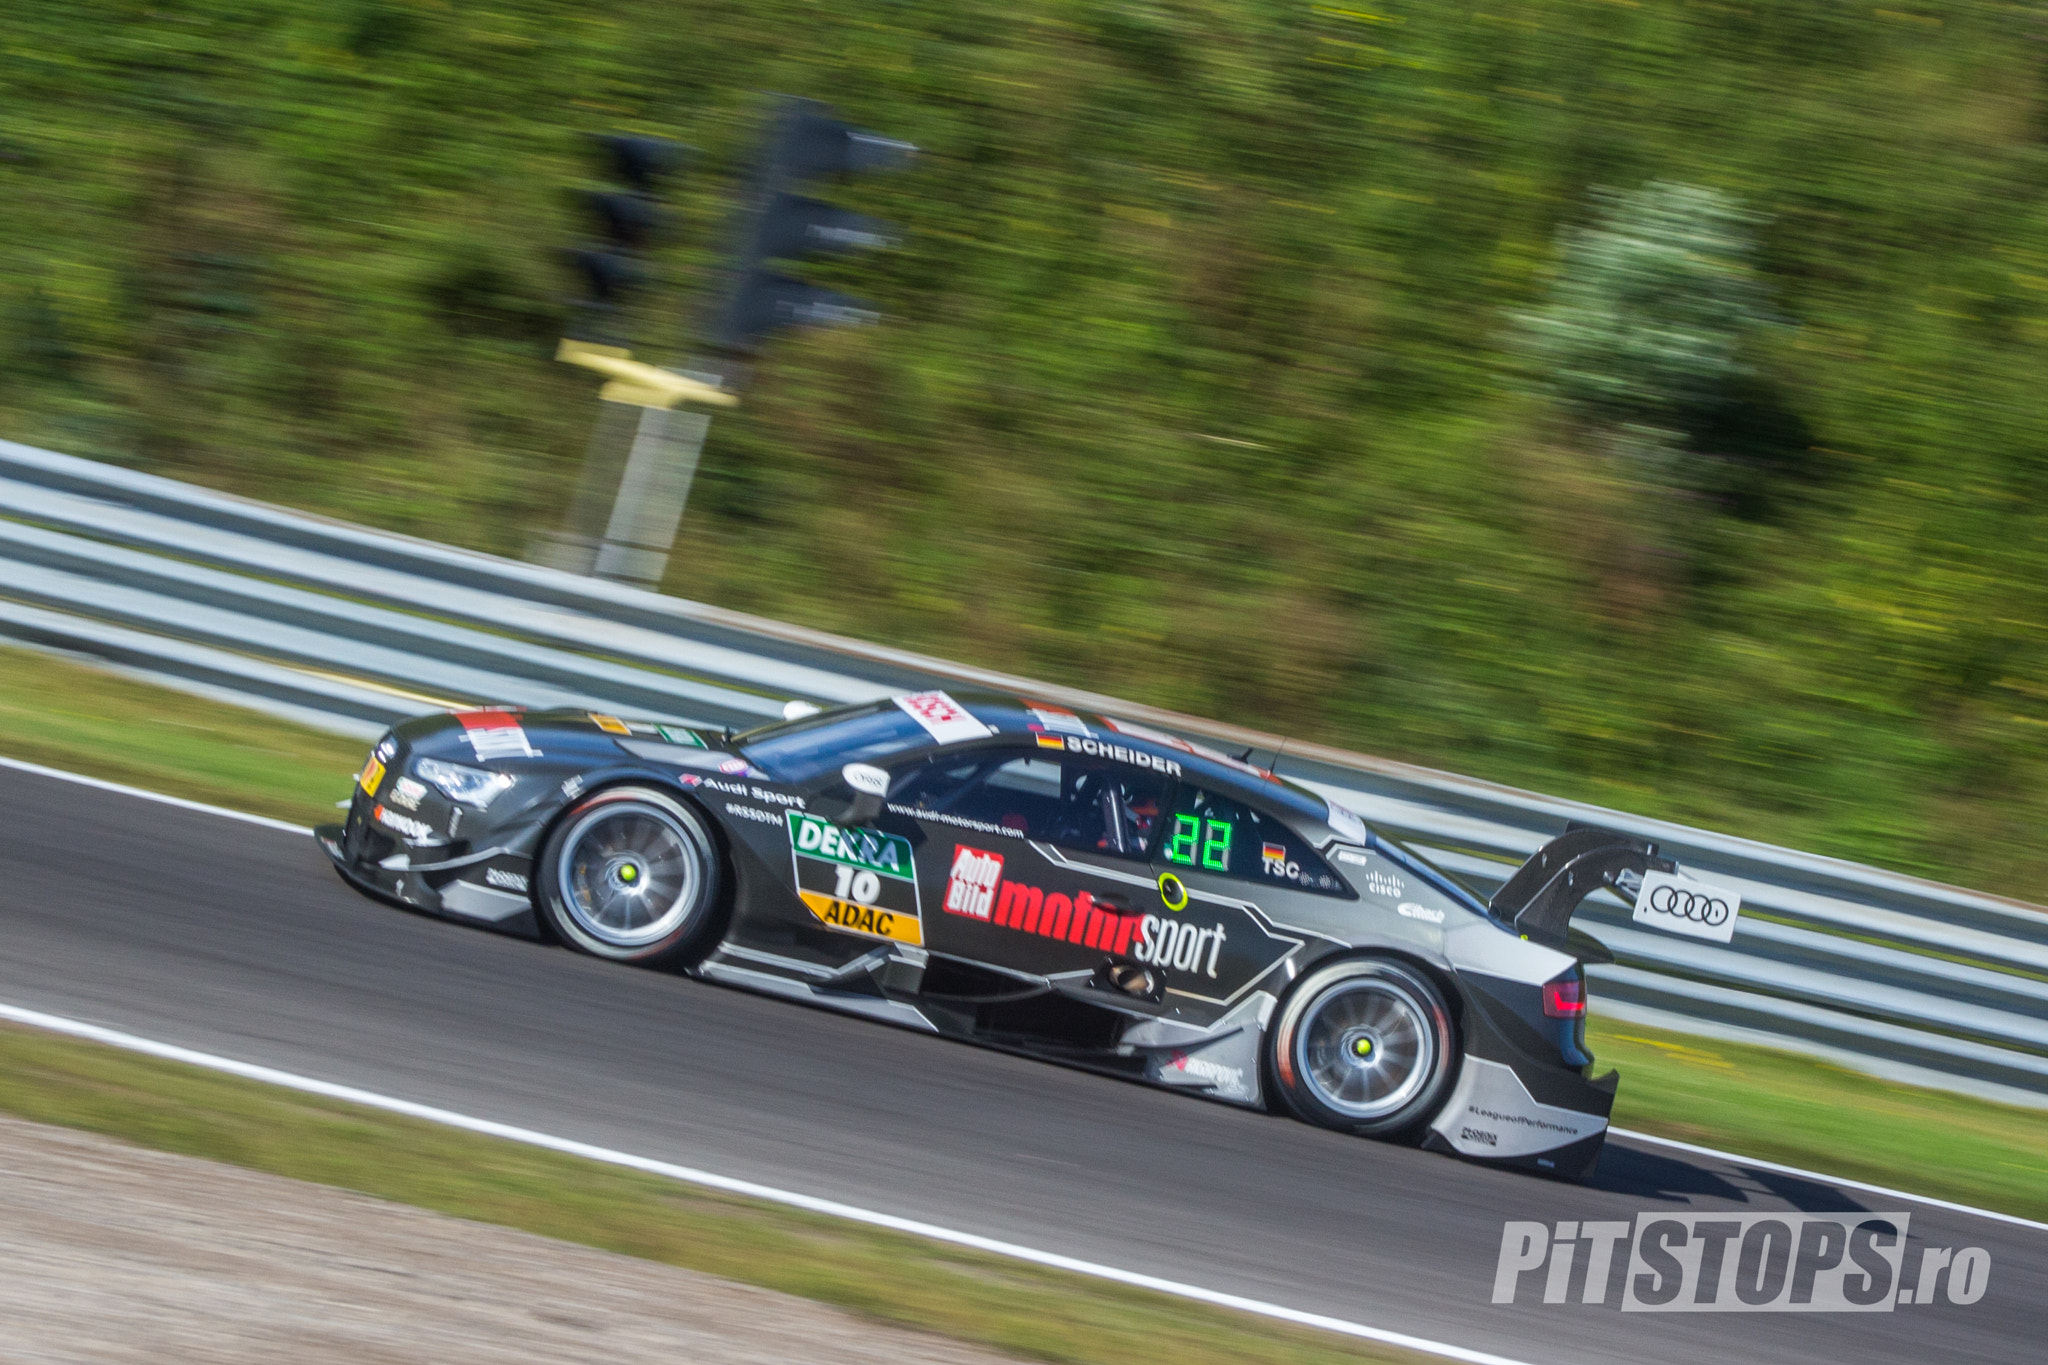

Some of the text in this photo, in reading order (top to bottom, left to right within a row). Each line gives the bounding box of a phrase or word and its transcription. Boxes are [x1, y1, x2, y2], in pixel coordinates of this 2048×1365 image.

[1067, 736, 1181, 777] SCHEIDER
[704, 778, 806, 809] Audi Sport
[887, 802, 1024, 839] www.audi-motorsport.com
[797, 819, 900, 872] DEKRA
[1172, 813, 1232, 872] 22
[834, 863, 881, 905] 10
[951, 848, 1001, 888] Auto
[946, 881, 993, 918] Bild
[1369, 882, 1401, 898] cisco
[824, 901, 895, 935] ADAC
[1468, 1105, 1579, 1135] #LeagueofPerformance
